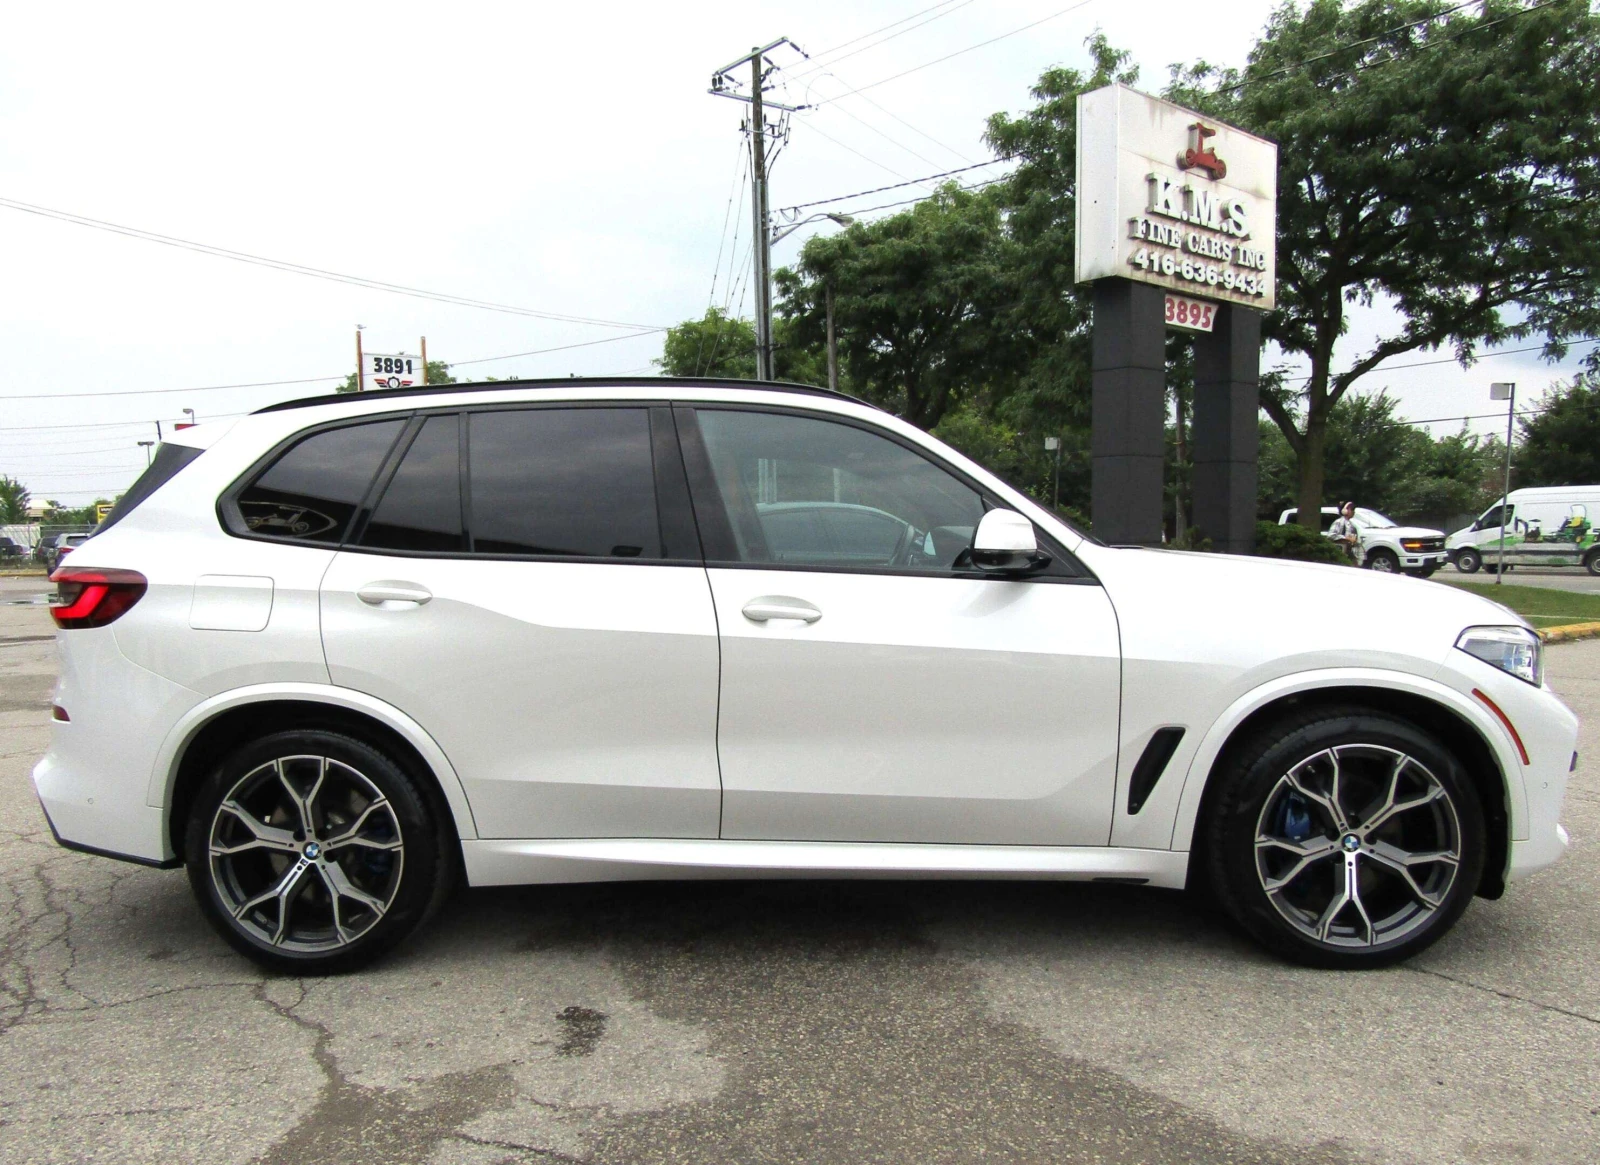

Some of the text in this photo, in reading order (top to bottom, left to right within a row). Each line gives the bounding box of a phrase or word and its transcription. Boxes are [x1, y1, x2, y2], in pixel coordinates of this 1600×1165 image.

[1131, 216, 1181, 249] FINE
[1185, 232, 1232, 263] CARS
[1131, 247, 1265, 297] 416-636-9434
[1165, 297, 1212, 329] 3895
[373, 357, 412, 375] 3891
